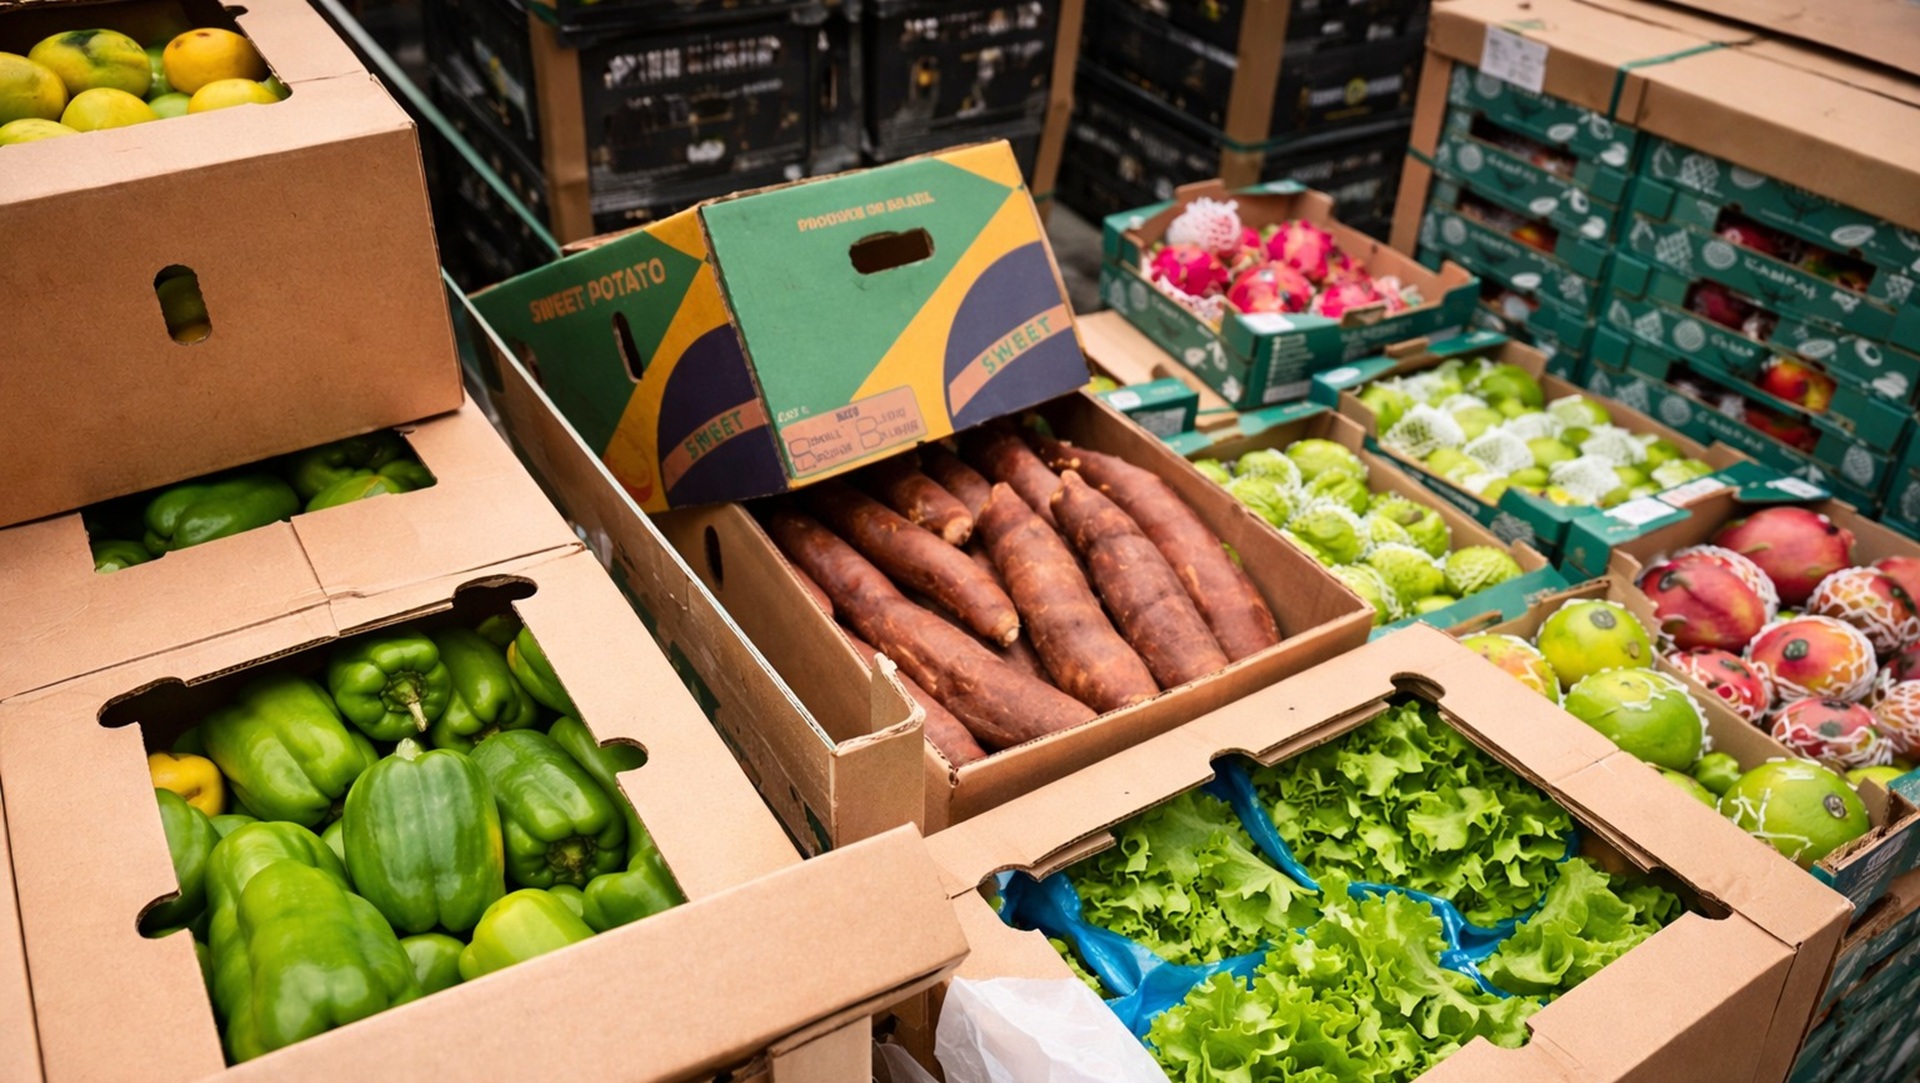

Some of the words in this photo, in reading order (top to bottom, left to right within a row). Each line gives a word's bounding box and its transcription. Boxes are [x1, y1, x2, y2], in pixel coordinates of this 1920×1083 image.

[529, 285, 585, 323] SWEET
[587, 257, 666, 306] POTATO
[981, 315, 1051, 375] SWEET
[683, 410, 744, 460] SWEET
